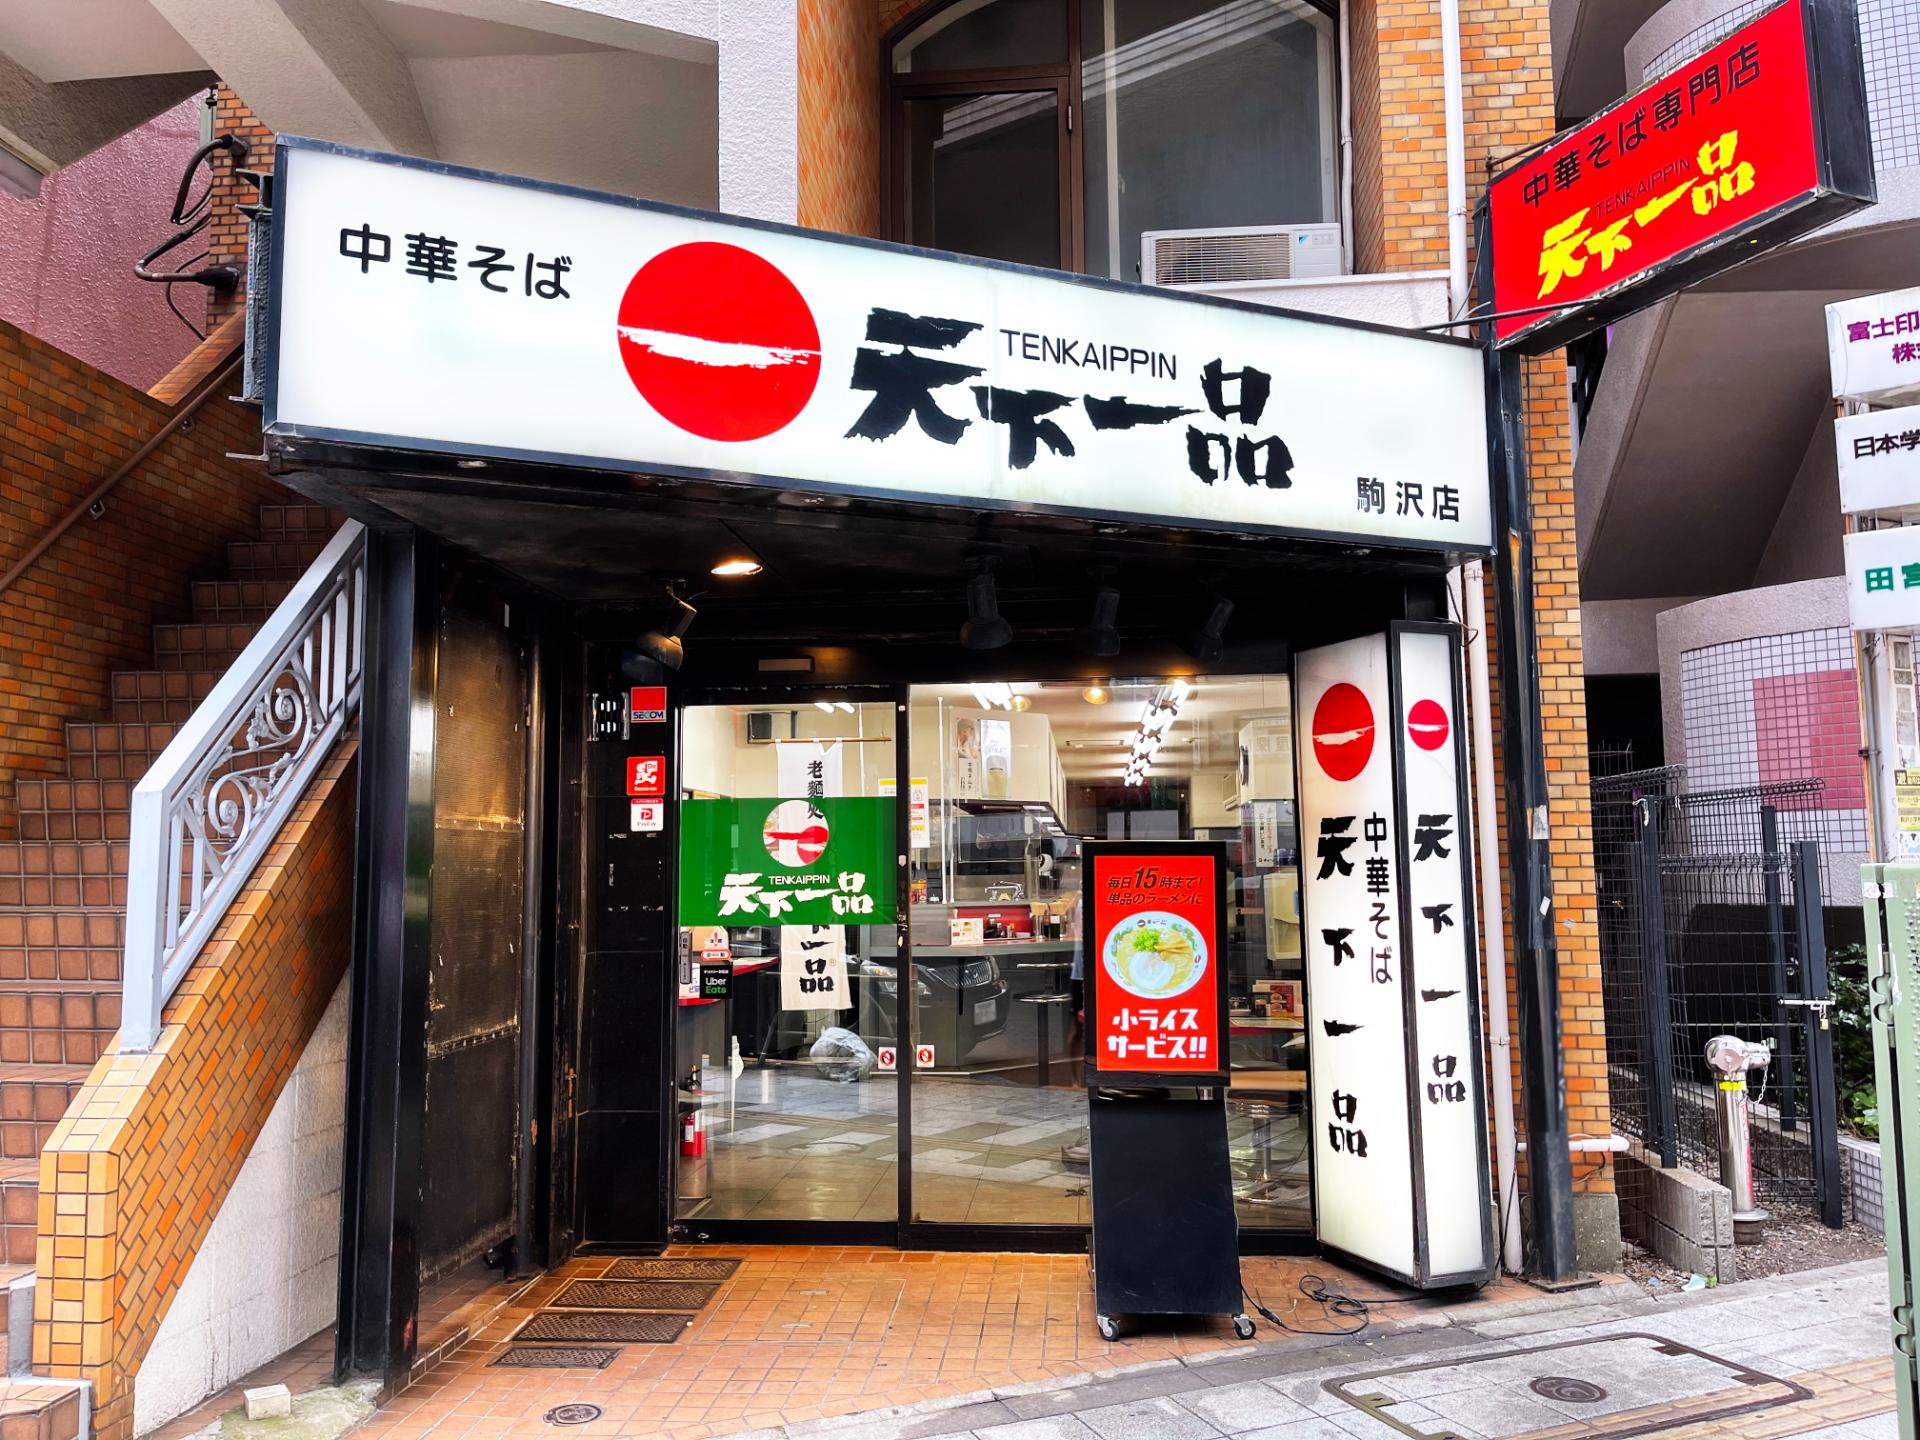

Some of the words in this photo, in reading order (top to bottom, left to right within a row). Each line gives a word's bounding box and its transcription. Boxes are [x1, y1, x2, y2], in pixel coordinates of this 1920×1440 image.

[1522, 40, 1760, 208] 中華そば専門店
[1595, 157, 1691, 218] TENKAIPPIN
[1537, 130, 1756, 300] 天下一品
[339, 222, 571, 300] 中華そば
[1847, 310, 1920, 344] 富士印
[1000, 329, 1177, 381] TENKAIPPIN
[1892, 341, 1920, 364] 株
[842, 307, 1293, 490] 天下一品
[1357, 476, 1460, 523] 駒沢店
[633, 711, 664, 720] SECOM
[718, 871, 874, 917] 天下一品
[768, 874, 830, 885] TENKAIPPIN
[1107, 867, 1203, 890] 毎日15時まで!
[1107, 892, 1202, 905] 単品のラーメンに
[1363, 811, 1393, 984] 中華そば
[705, 976, 727, 986] Uber
[1413, 814, 1466, 1105] 天下一品
[705, 985, 727, 994] Eats
[1316, 815, 1368, 1158] 天下一品
[1112, 1008, 1199, 1032] 小ライス
[1106, 1034, 1208, 1059] サービス!!
